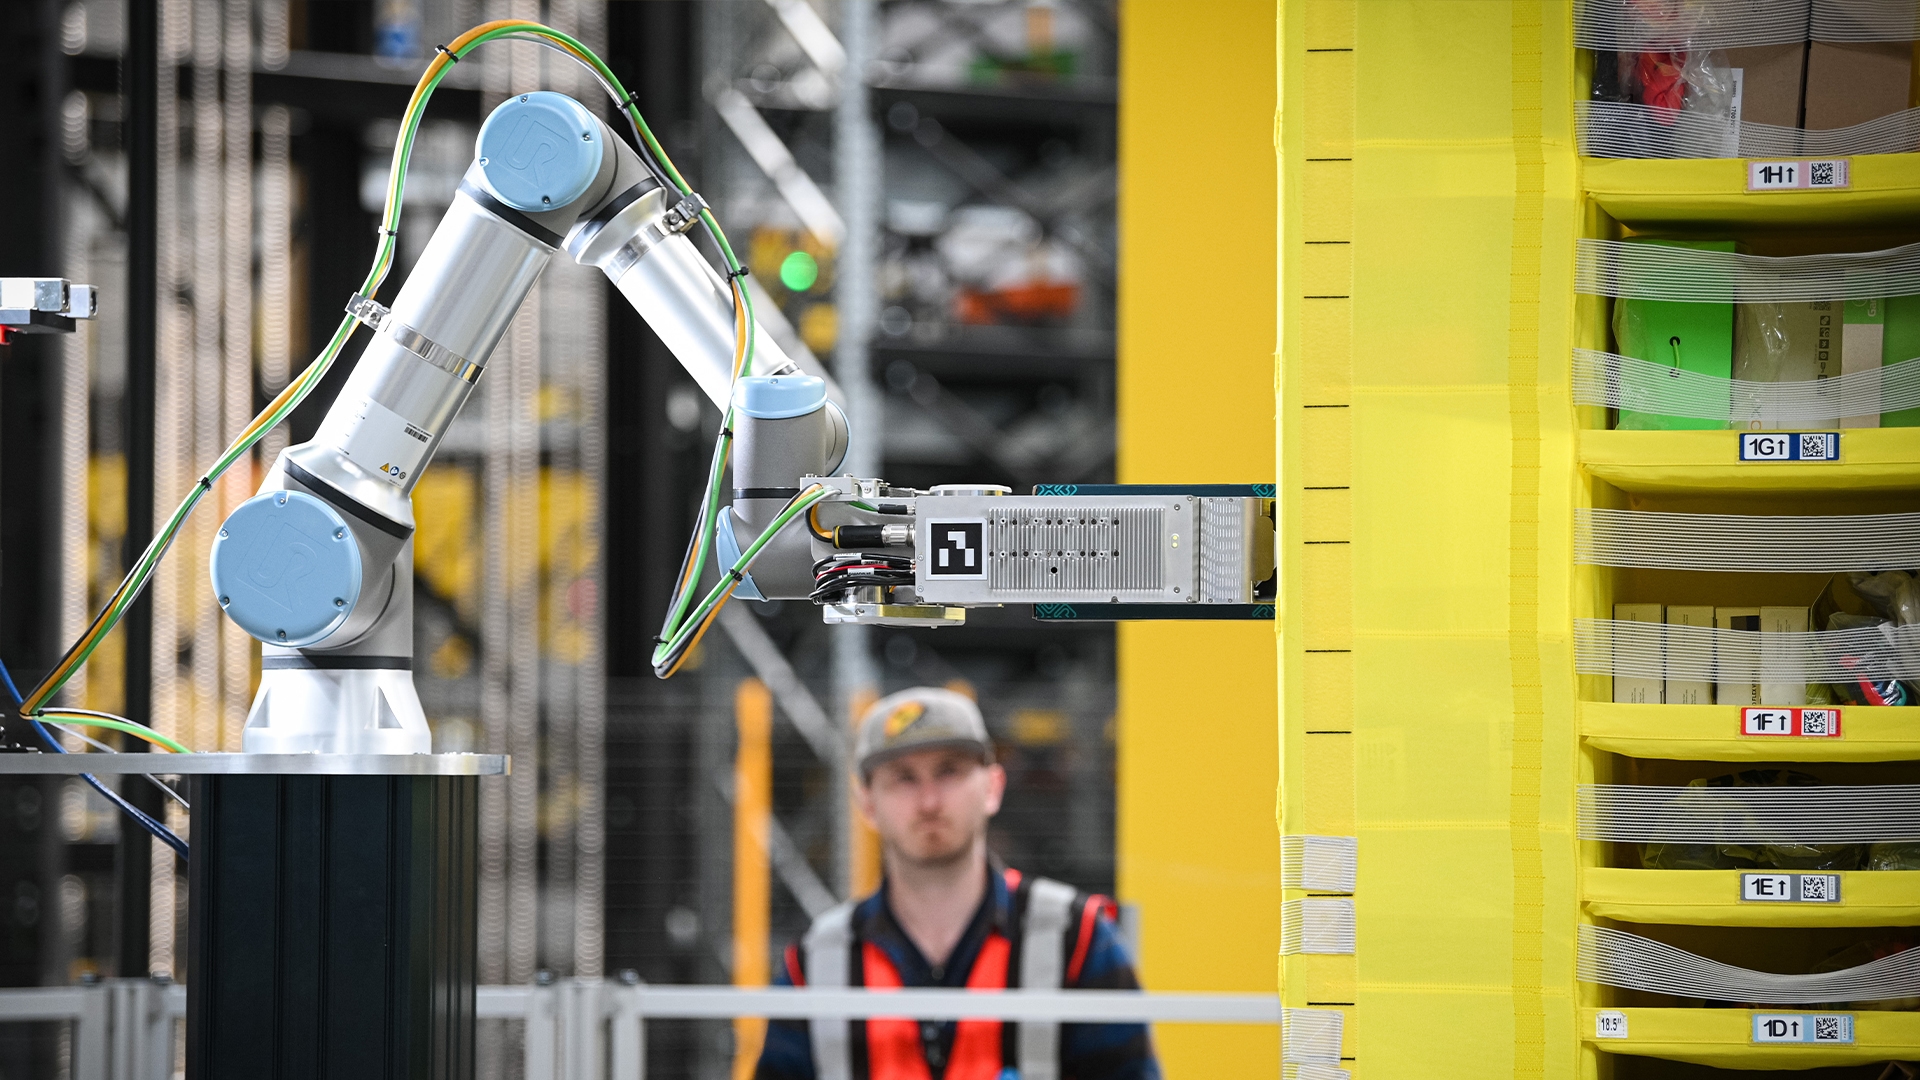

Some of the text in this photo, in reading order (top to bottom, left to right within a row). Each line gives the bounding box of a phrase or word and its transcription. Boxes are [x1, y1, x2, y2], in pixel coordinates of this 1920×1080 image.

[1758, 165, 1783, 184] 1H
[1748, 437, 1775, 456] 1G
[1752, 713, 1774, 731] 1F
[1751, 877, 1774, 896] 1E
[1601, 1017, 1622, 1031] 18.5"
[1763, 1019, 1787, 1037] 1D
